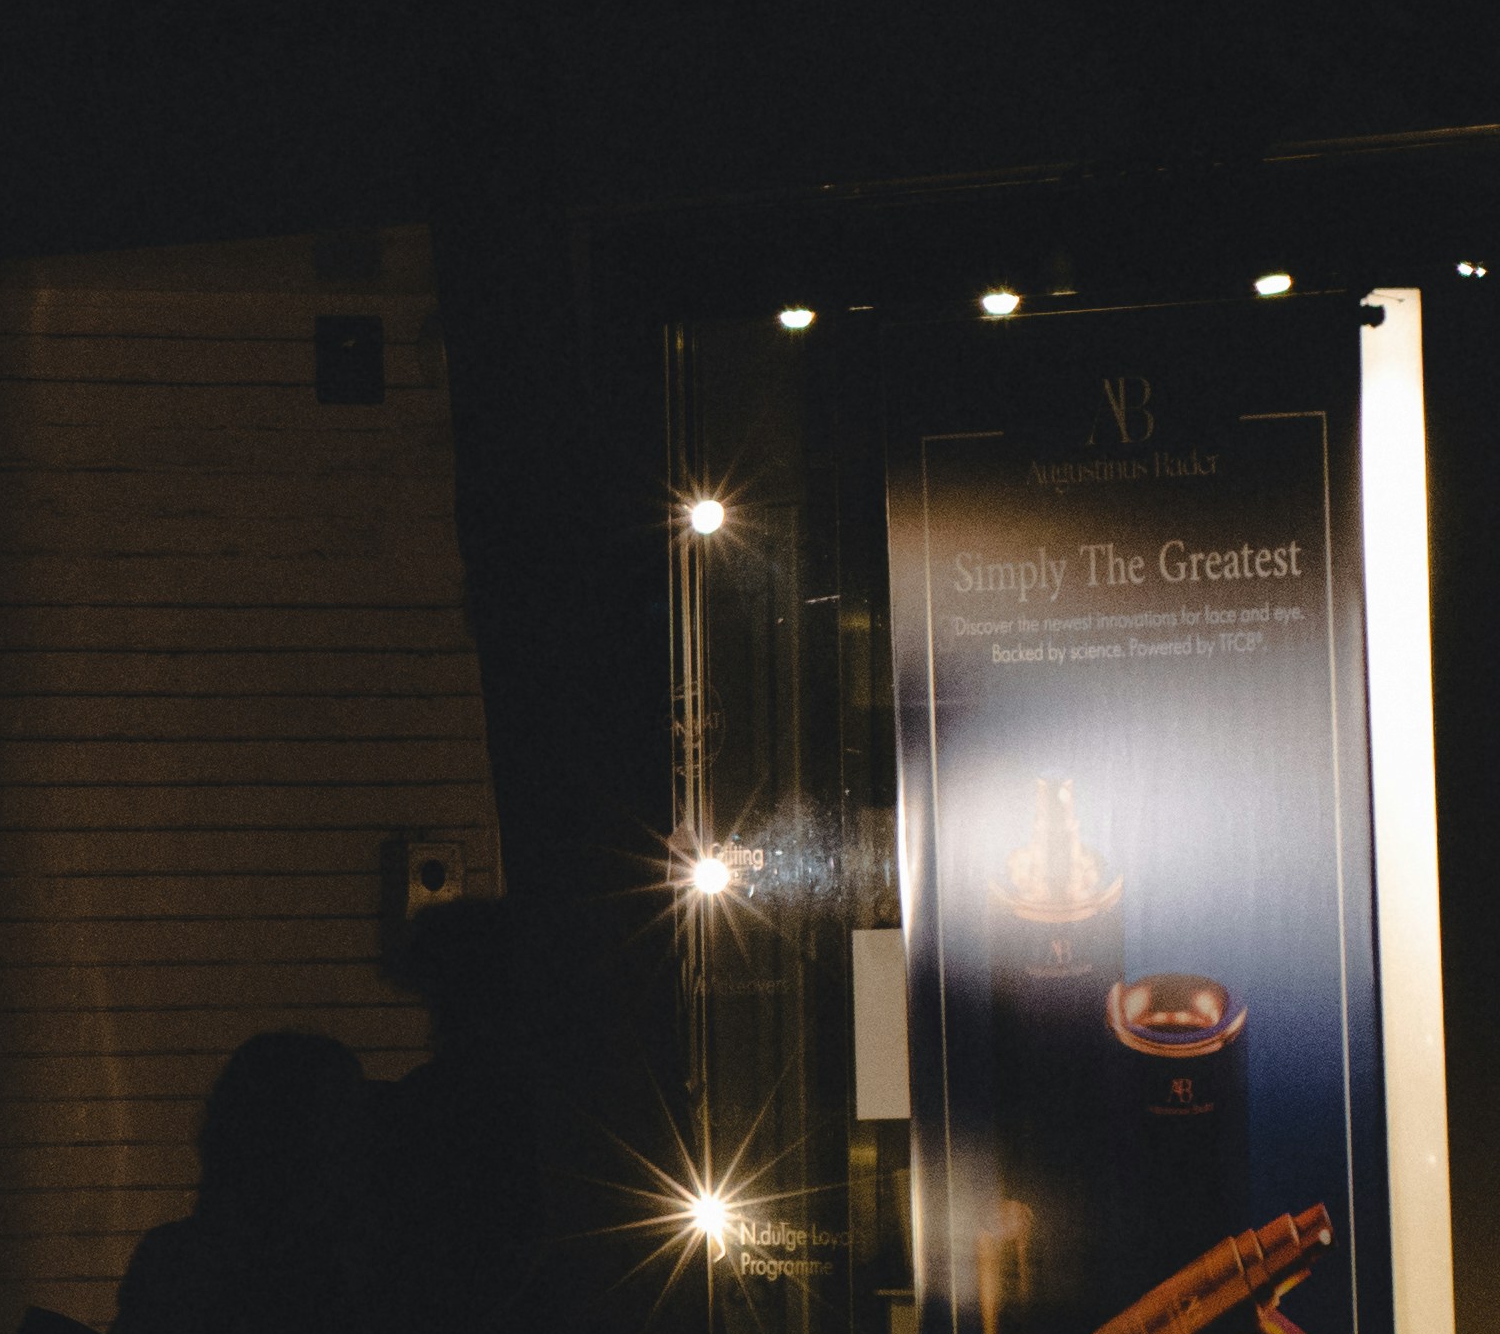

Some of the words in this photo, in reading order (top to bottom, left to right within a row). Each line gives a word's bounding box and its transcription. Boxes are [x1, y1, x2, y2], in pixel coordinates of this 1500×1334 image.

[954, 545, 1068, 604] Simply
[1079, 542, 1146, 587] The
[1159, 538, 1302, 584] Greatest
[955, 614, 1013, 637] Discover
[1018, 613, 1040, 633] the
[1043, 613, 1092, 632] newest
[1097, 608, 1178, 630] innovations
[1181, 603, 1201, 627] for
[1204, 603, 1237, 625] face
[1240, 602, 1270, 623] and
[992, 641, 1044, 665] Backed
[1047, 641, 1067, 665] by
[1069, 638, 1127, 662] science.
[1129, 636, 1193, 658] Powered
[1195, 635, 1216, 658] by
[740, 1252, 834, 1282] Programme
